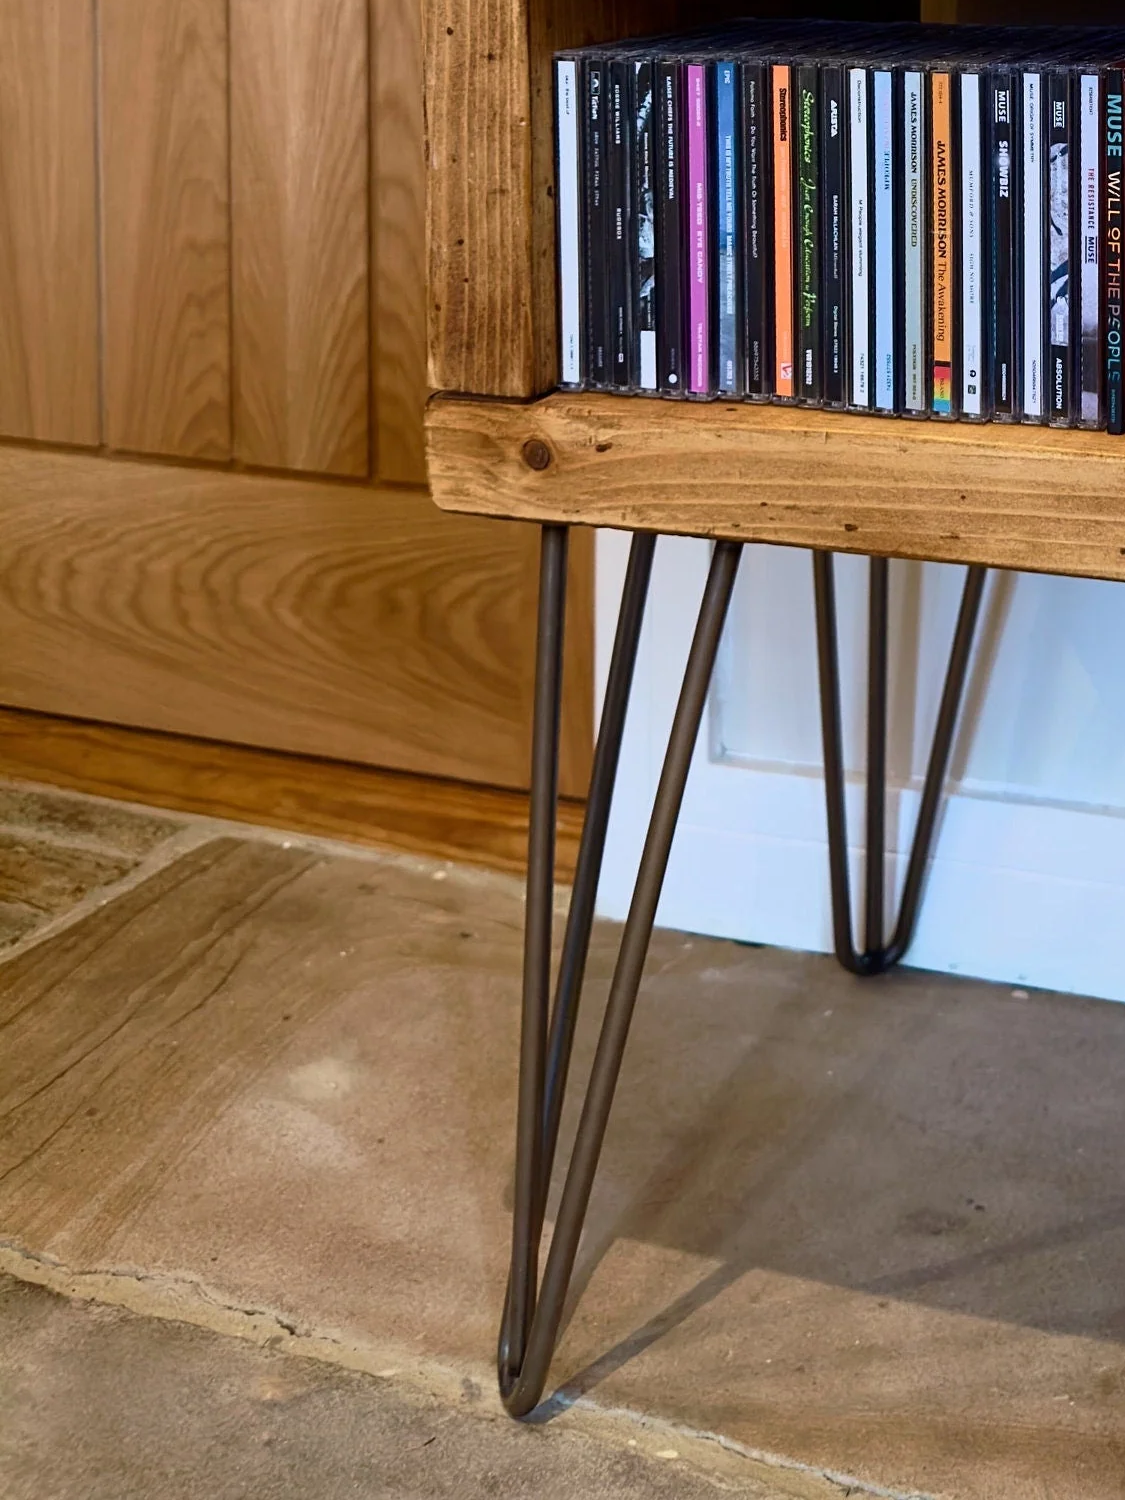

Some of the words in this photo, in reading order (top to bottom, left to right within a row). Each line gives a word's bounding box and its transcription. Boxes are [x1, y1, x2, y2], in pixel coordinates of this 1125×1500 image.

[997, 91, 1007, 122] MUSE
[1055, 101, 1063, 128] MUSE
[801, 90, 815, 163] Stereophonics
[1107, 94, 1122, 157] MUSE
[937, 141, 946, 185] JAMES
[998, 140, 1009, 197] SHOWBIZ
[800, 177, 816, 201] Just
[803, 204, 815, 235] Enough
[937, 188, 946, 258] MORRISON
[1087, 236, 1095, 264] MUSE
[1107, 226, 1121, 253] OF
[938, 262, 947, 281] The
[1107, 259, 1121, 299] THE
[802, 292, 817, 327] Perform
[936, 283, 947, 341] Awakening
[1107, 304, 1121, 381] PEOPLE
